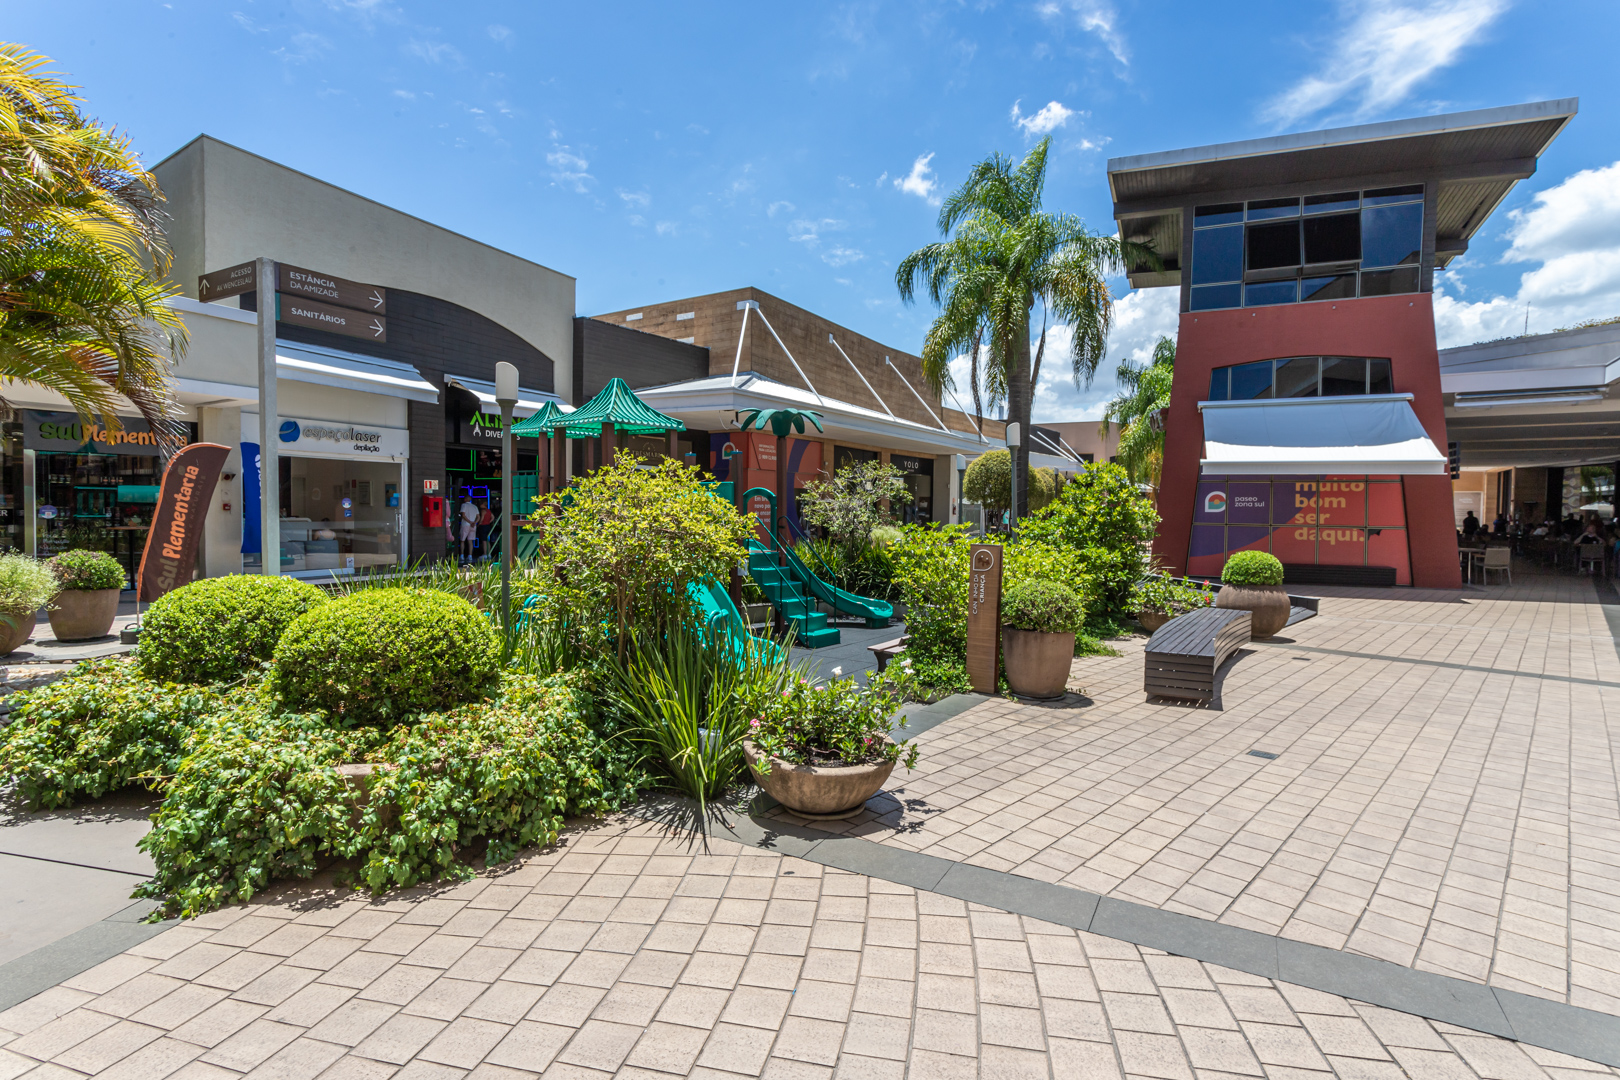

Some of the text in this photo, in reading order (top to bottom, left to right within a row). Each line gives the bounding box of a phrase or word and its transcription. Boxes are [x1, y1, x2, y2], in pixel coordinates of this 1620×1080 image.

[230, 266, 252, 279] ACESSO
[290, 271, 336, 289] ESTÂNCIA
[290, 281, 339, 299] DA AMIZADE
[291, 307, 346, 326] SANITÁRIOS
[353, 443, 380, 453] depilação
[903, 460, 919, 470] YOLO
[1295, 478, 1365, 492] muito
[1234, 496, 1258, 504] paseo
[1295, 493, 1346, 508] bom
[1294, 512, 1330, 524] ser
[1294, 527, 1365, 546] daqui.
[974, 573, 979, 583] DA
